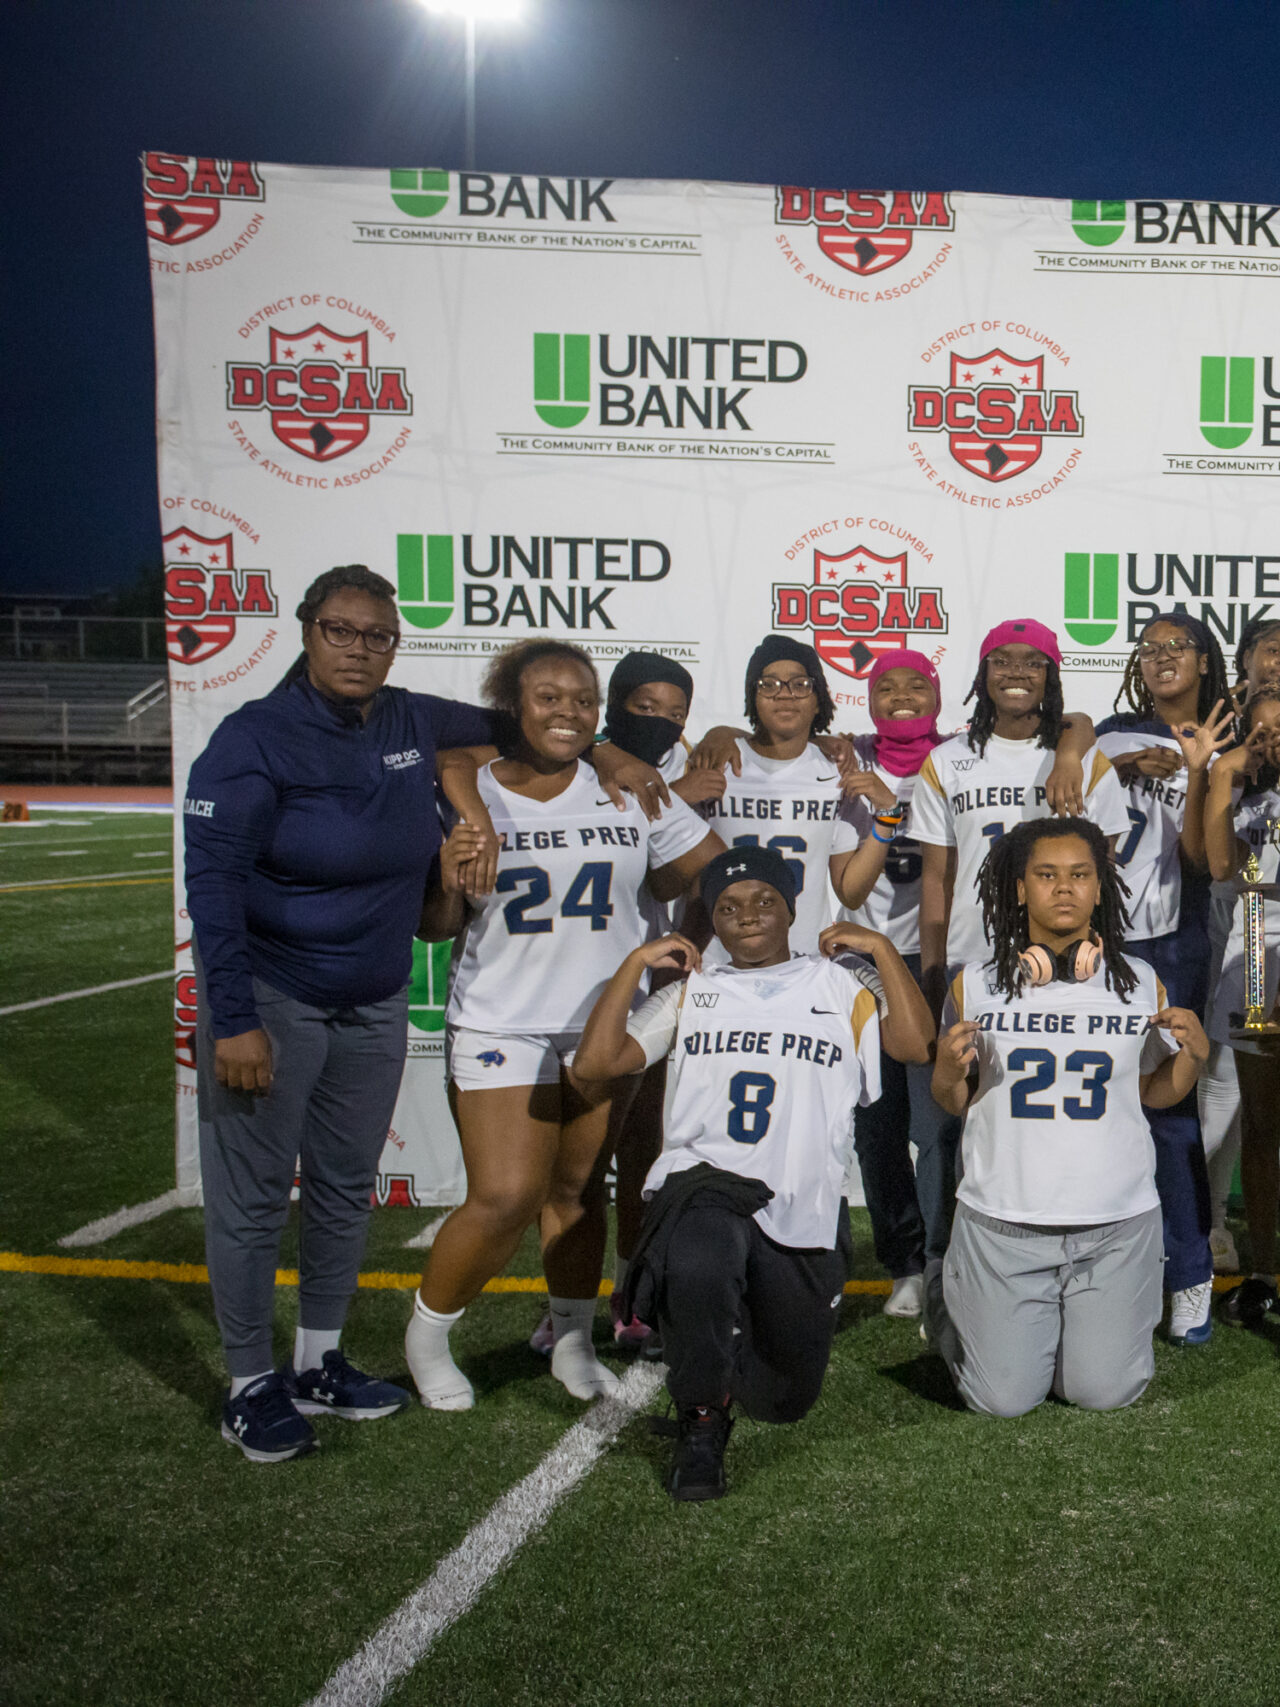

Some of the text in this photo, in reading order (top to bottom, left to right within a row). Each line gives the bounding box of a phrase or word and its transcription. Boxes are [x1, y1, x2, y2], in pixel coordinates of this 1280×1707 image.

[143, 151, 265, 202] SAA
[458, 173, 617, 222] BANK
[775, 186, 955, 233] DCSAA
[186, 212, 265, 273] ASSOCIATION
[775, 234, 952, 302] STATE ATHLETIC ASSOCIATION
[238, 294, 396, 342] DISTRICT OF COLUMBIA
[598, 333, 808, 383] UNITED
[920, 320, 1071, 367] DISTRICT OF COLUMBIA
[226, 359, 413, 418] DCSAA
[598, 383, 753, 430] BANK
[907, 382, 1084, 440] DCSAA
[228, 420, 412, 489] STATE ATHLETIC ASSOCIATION
[908, 442, 1082, 508] STATE ATHLETIC ASSOCIATION
[163, 497, 261, 545] OF COLUMBIA
[784, 517, 935, 564] DISTRICT OF COLUMBIA
[462, 534, 672, 582] UNITED
[165, 562, 279, 621] SAA
[463, 583, 617, 630] BANK
[772, 579, 948, 637] DCSAA
[202, 629, 278, 691] ASSOCIATION
[577, 826, 640, 848] PREP
[495, 861, 614, 936] 24
[975, 1012, 1076, 1034] OLLEGE
[781, 1033, 842, 1068] PREP
[727, 1070, 777, 1145] 8
[1007, 1048, 1114, 1121] 23
